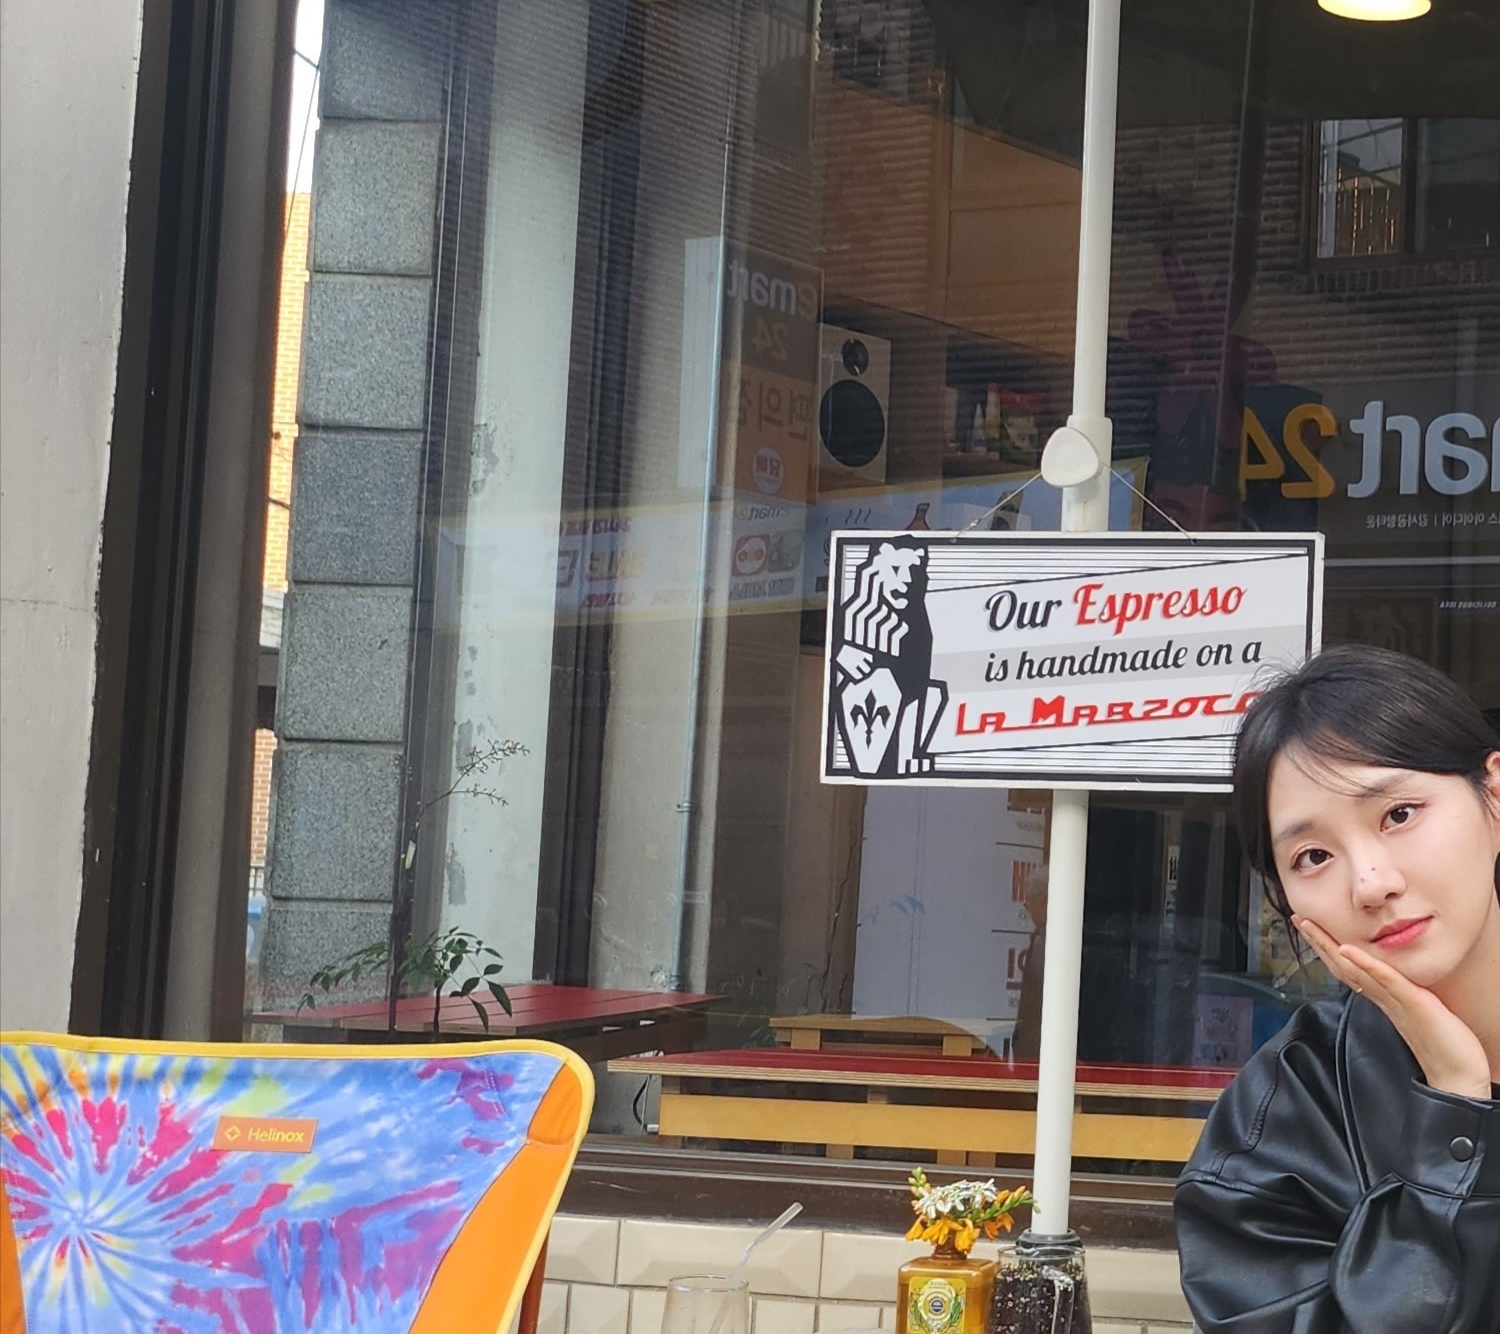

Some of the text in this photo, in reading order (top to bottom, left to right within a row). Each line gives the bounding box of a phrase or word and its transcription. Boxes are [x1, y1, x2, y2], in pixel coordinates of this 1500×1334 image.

[985, 581, 1248, 636] Our Espresso
[984, 639, 1263, 684] is handmade on a
[247, 1127, 305, 1143] Helinox
